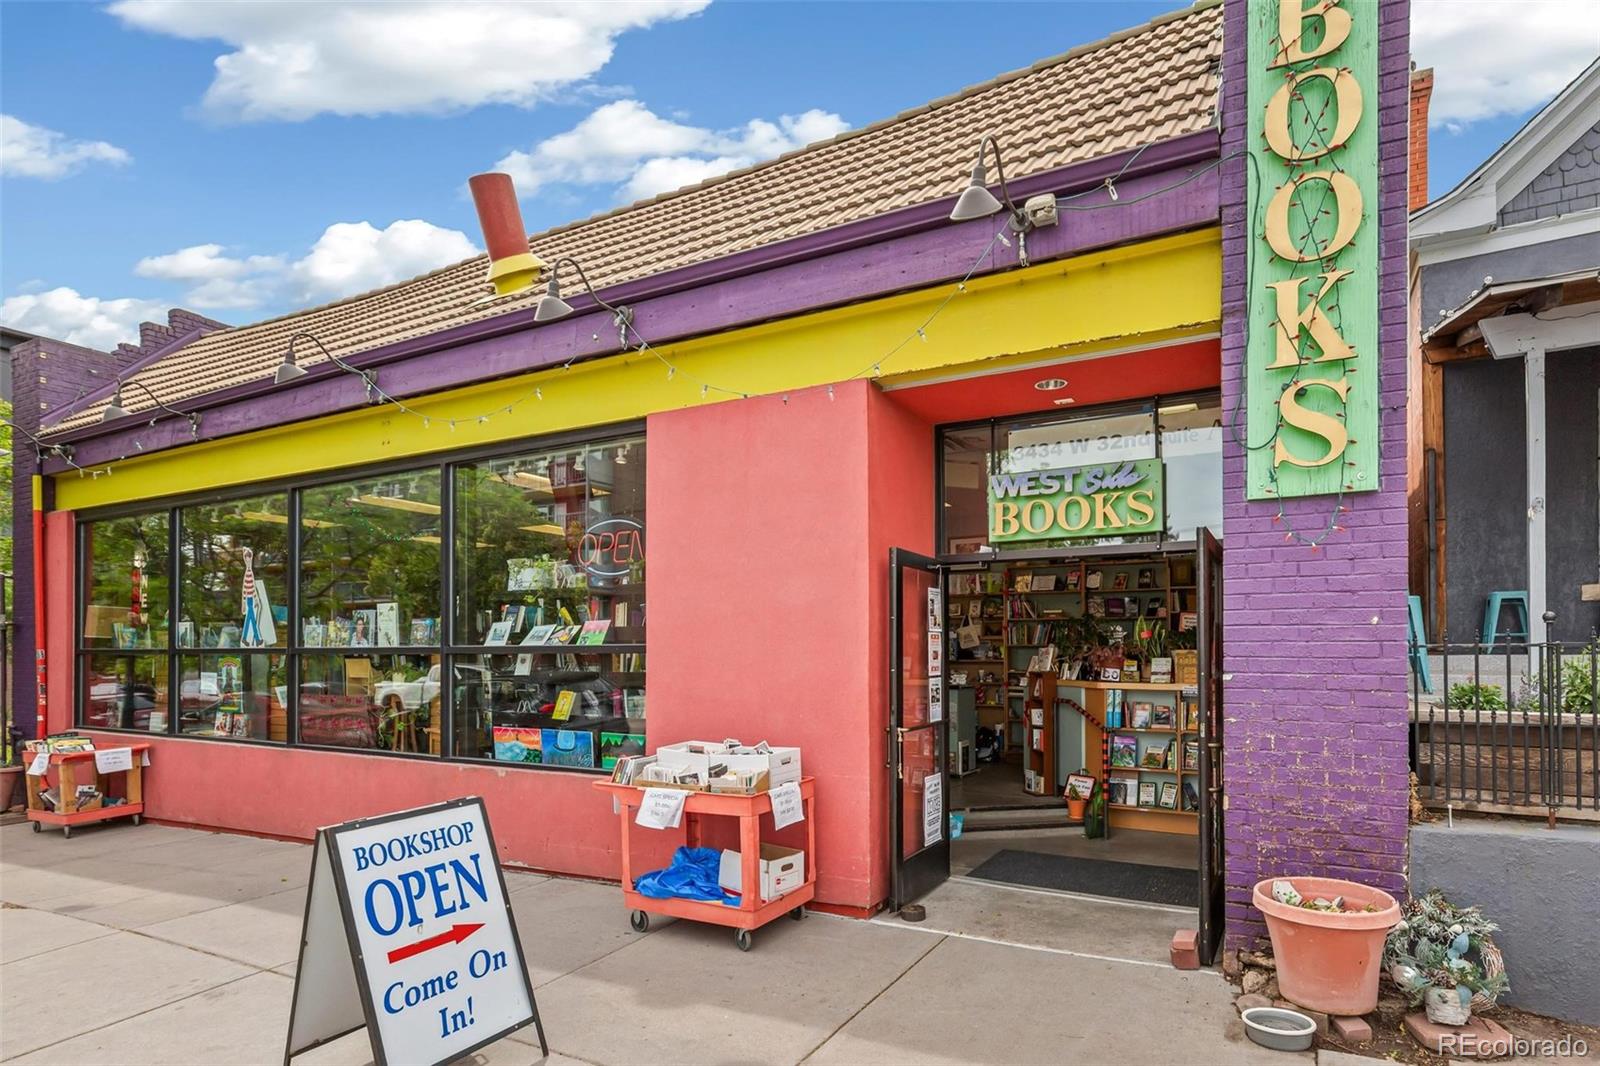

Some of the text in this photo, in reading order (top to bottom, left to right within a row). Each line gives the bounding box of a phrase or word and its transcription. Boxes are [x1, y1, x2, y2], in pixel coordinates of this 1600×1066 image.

[1266, 0, 1364, 468] BOOKS
[1068, 437, 1090, 455] W
[990, 460, 1149, 499] WEST Side
[992, 489, 1155, 537] BOOKS
[353, 821, 474, 871] BOOKSHOP
[364, 853, 488, 937] OPEN
[383, 949, 508, 1015] Come On
[438, 996, 475, 1038] In!
